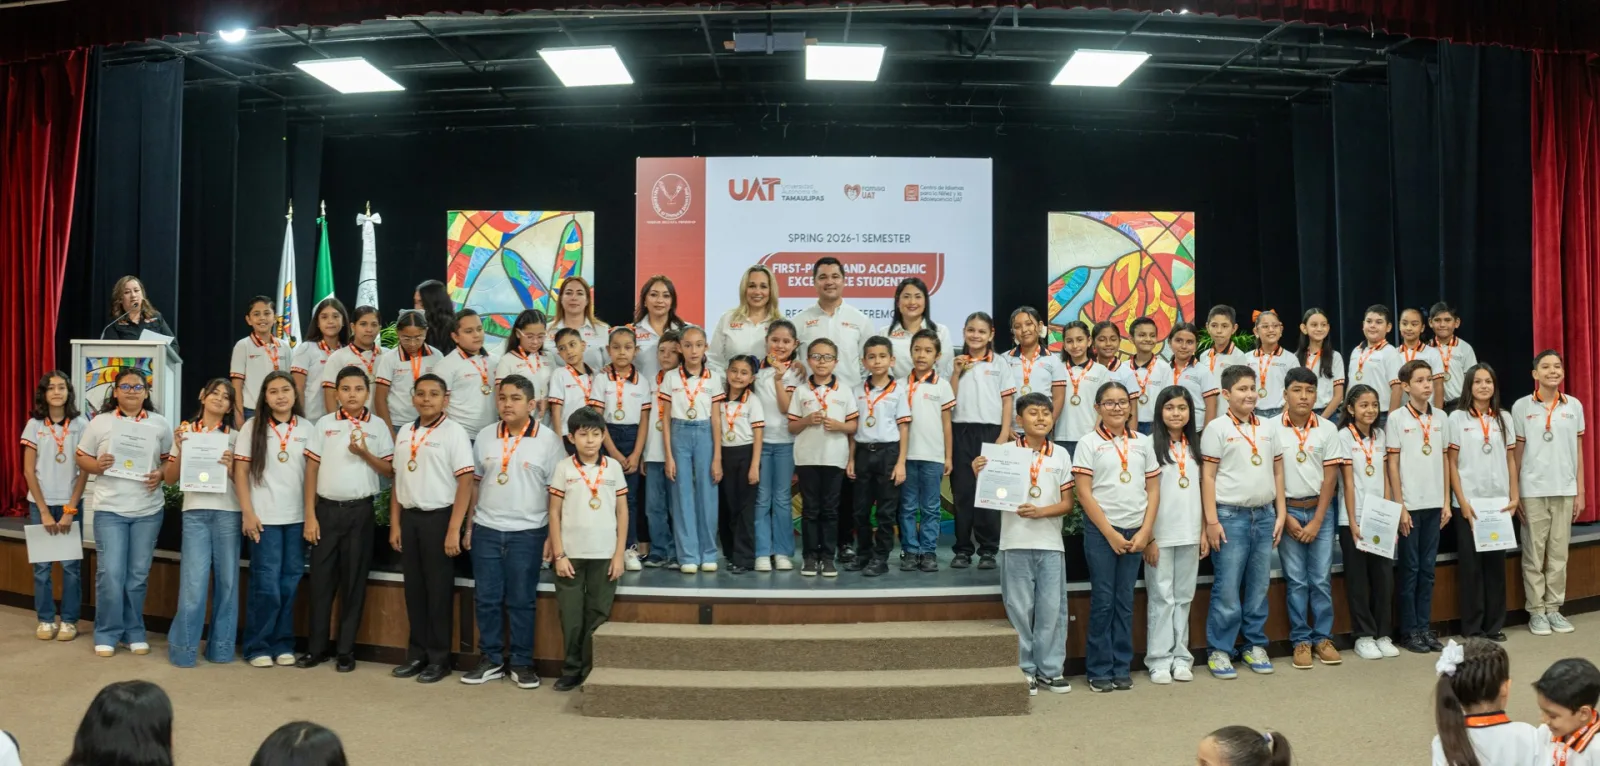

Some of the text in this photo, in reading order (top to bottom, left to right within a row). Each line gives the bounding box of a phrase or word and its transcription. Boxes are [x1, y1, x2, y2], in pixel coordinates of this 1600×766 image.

[728, 177, 781, 201] UAT
[788, 233, 911, 243] SPRING 2026-1 SEMESTER
[772, 263, 927, 274] FIRST-P AND ACADEMIC
[856, 277, 904, 287] STUDENT
